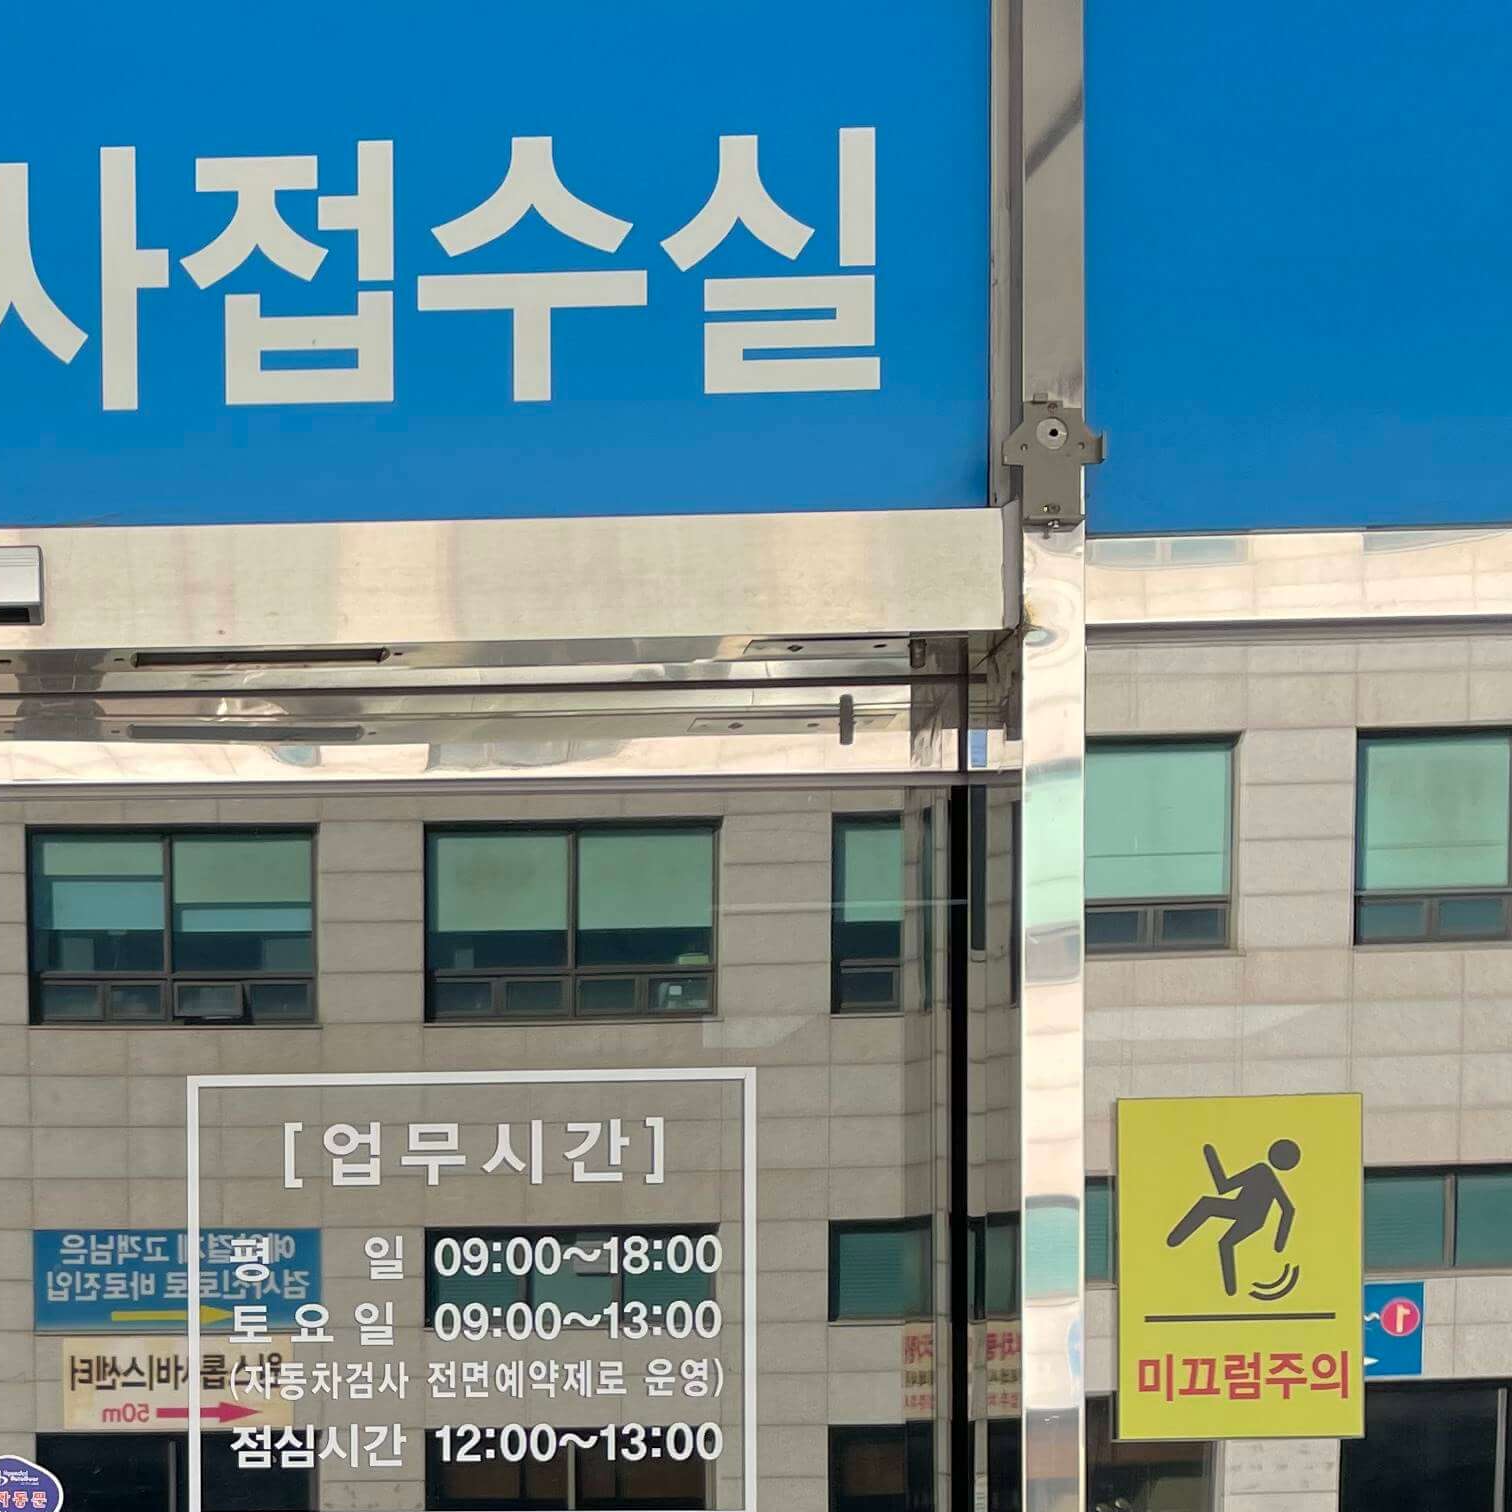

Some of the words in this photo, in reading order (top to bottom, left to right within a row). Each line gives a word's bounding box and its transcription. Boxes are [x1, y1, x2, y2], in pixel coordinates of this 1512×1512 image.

[433, 1234, 723, 1278] 09:00~18:00
[433, 1299, 724, 1342] 09:00~13:00
[229, 1361, 410, 1402] (자동차검사
[427, 1359, 627, 1400] 전면예약제로
[643, 1356, 725, 1398] 운영)
[1138, 1351, 1349, 1401] 미끄럼주의
[229, 1424, 406, 1470] 점심시간
[435, 1421, 724, 1463] 12:00~13:00
